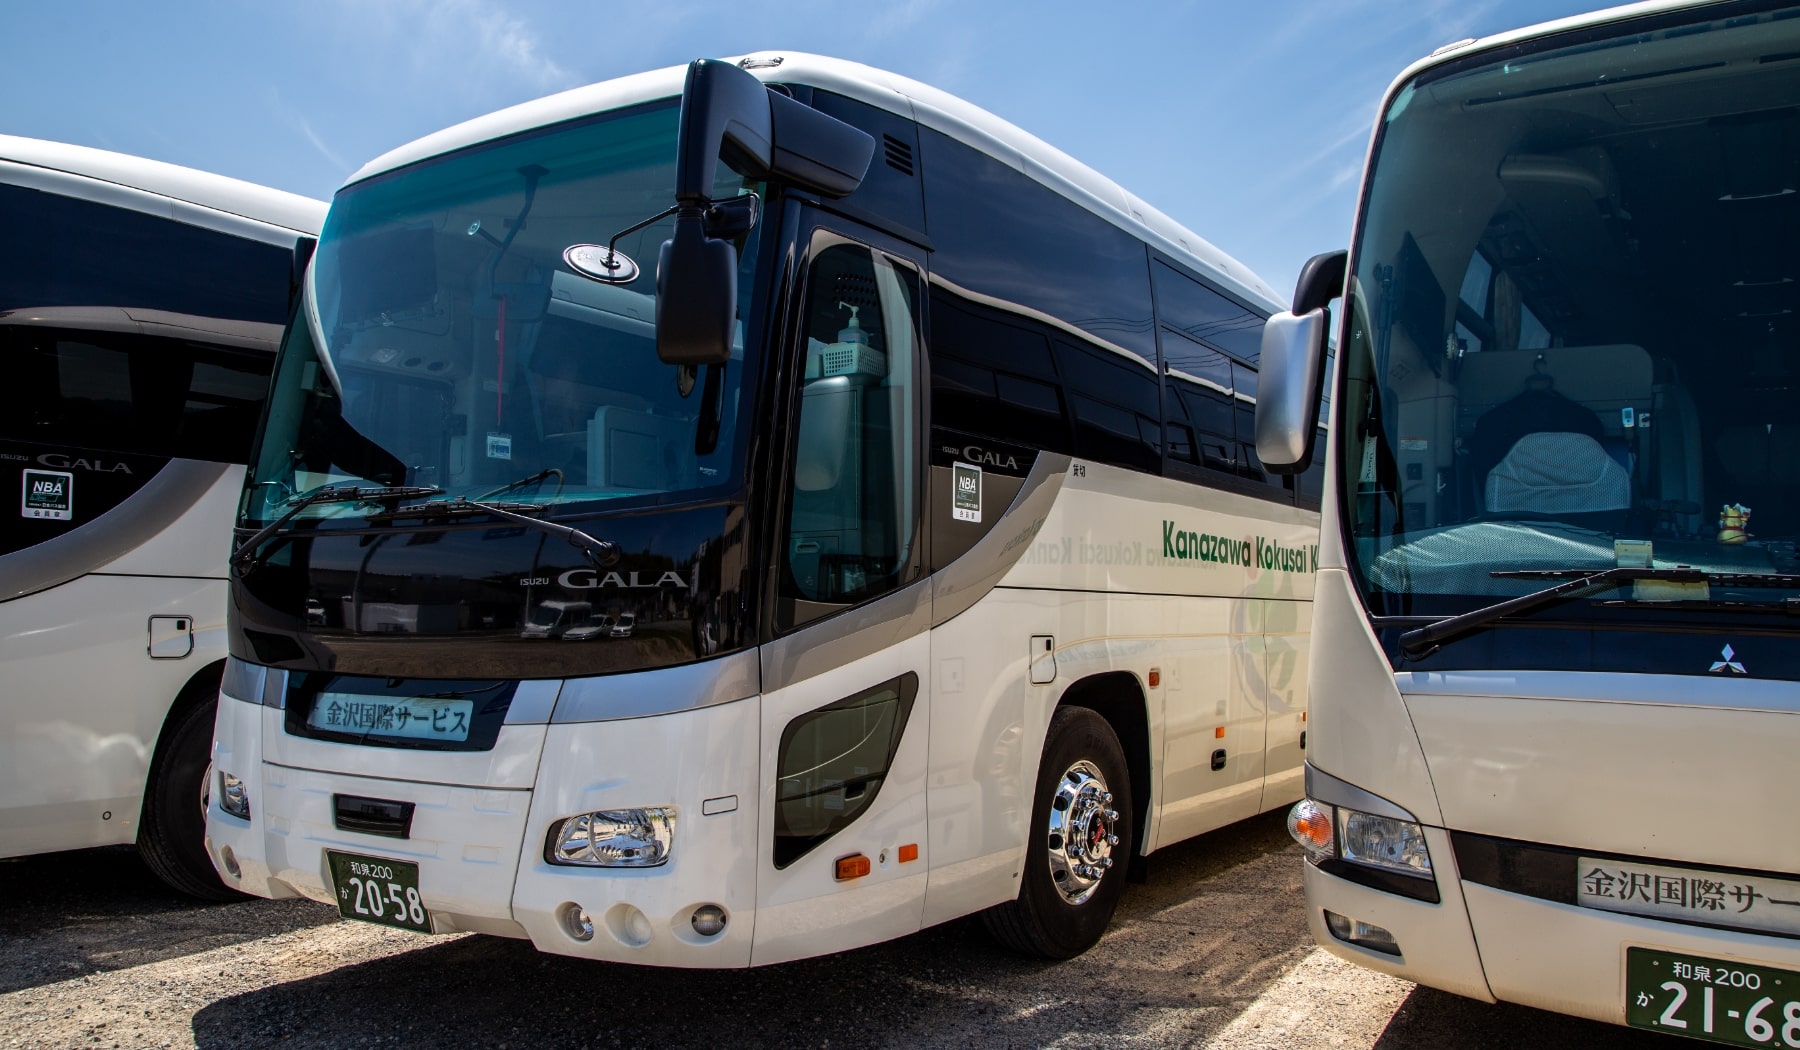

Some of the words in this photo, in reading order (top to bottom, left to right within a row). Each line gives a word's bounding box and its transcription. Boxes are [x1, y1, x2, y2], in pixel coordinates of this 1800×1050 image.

[0, 453, 29, 461] ISUZU
[37, 453, 133, 474] GALA
[942, 445, 959, 455] ISUZU
[963, 446, 1018, 470] GALA
[33, 481, 62, 493] NBA
[959, 476, 976, 490] NBA
[1163, 520, 1251, 567] Kanazawa
[1256, 536, 1307, 573] Kokusai
[520, 577, 549, 586] ISUZU
[558, 569, 689, 589] GALA
[326, 700, 467, 734] 金沢国際サービス
[341, 887, 349, 899] か
[349, 877, 425, 925] 20-58
[1584, 867, 1800, 912] 金沢国際サー
[1637, 991, 1654, 1007] か
[1660, 981, 1800, 1048] 21-68
